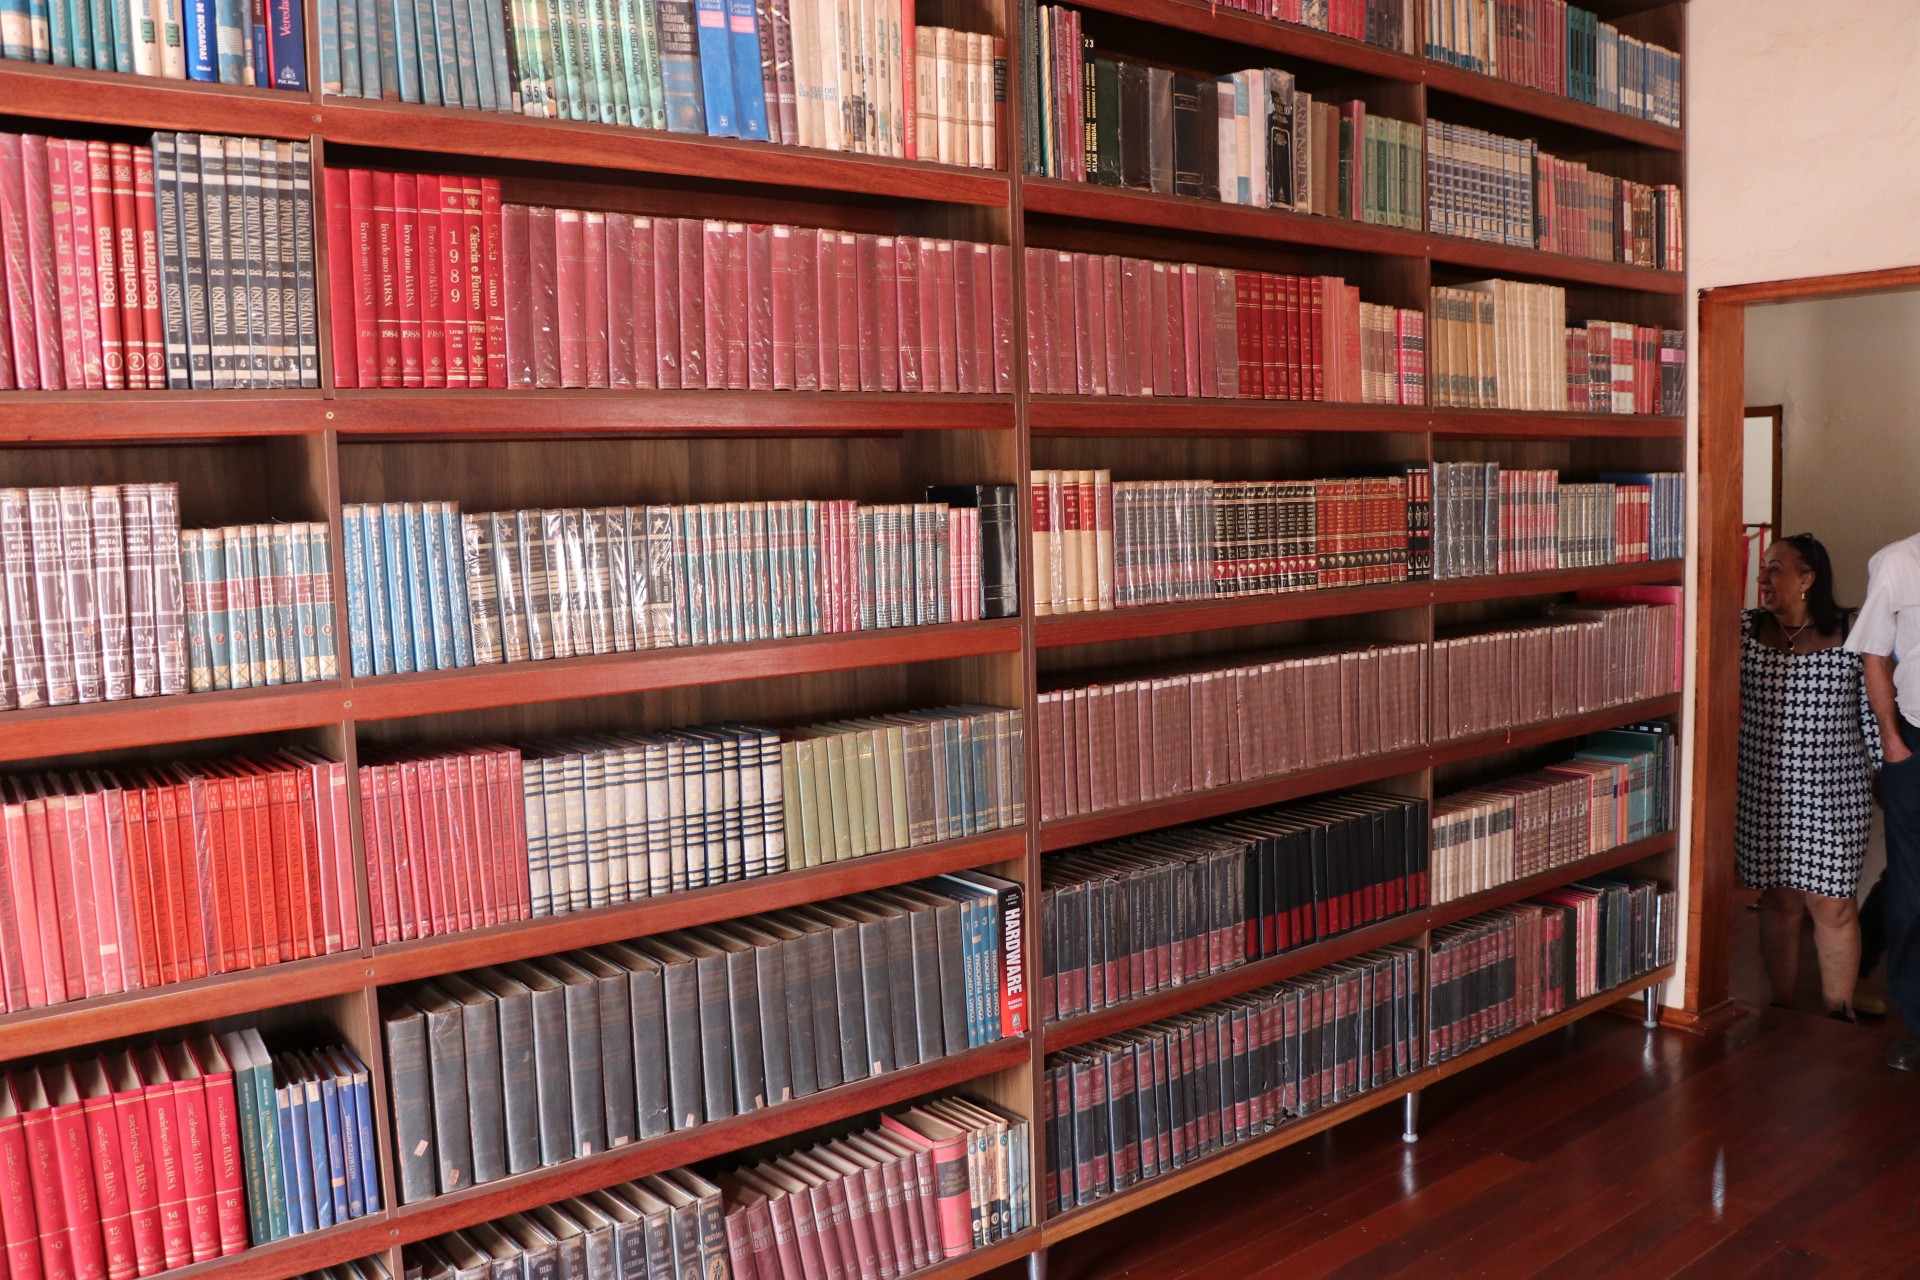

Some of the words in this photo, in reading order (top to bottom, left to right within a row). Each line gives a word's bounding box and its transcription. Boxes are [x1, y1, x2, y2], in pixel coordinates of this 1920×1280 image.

[661, 4, 677, 14] LISA
[662, 13, 685, 24] GRANDE
[197, 14, 208, 61] BIOGRAFIAS
[551, 18, 562, 66] MONTEIRO
[566, 19, 578, 66] MONTEIRO
[1084, 39, 1089, 48] 2
[1089, 39, 1094, 48] 3
[580, 23, 592, 70] MONTEIRO
[598, 24, 609, 71] MONTEIRO
[612, 24, 623, 72] MONTEIRO
[629, 27, 641, 75] MONTEIRO
[648, 30, 659, 77] MONTEIRO
[526, 85, 532, 98] 3
[534, 86, 540, 99] 5
[547, 87, 553, 99] 6
[906, 109, 916, 144] VIVER
[1296, 101, 1307, 202] DICTIONARY
[73, 160, 84, 174] 2
[161, 190, 178, 257] HUMANIDADE
[184, 192, 201, 258] HUMANIDADE
[207, 194, 224, 261] HUMANIDADE
[228, 194, 245, 261] HUMANIDADE
[246, 195, 262, 261] HUMANIDADE
[263, 197, 279, 262] HUMANIDADE
[280, 199, 295, 263] HUMANIDADE
[296, 199, 311, 262] HUMANIDADE
[360, 222, 369, 242] livro
[380, 223, 389, 243] livro
[403, 224, 412, 245] livro
[428, 225, 437, 245] livro
[362, 243, 370, 254] do
[381, 244, 390, 256] do
[404, 246, 413, 257] do
[428, 246, 437, 258] do
[469, 225, 480, 263] Ciência
[73, 185, 96, 341] NATURAMA
[98, 226, 116, 309] tecnirama
[120, 227, 139, 309] tecnirama
[141, 230, 159, 310] tecnirama
[165, 265, 180, 273] E
[362, 255, 370, 272] ano
[382, 256, 391, 273] ano
[405, 257, 414, 275] ano
[428, 258, 437, 274] ano
[449, 230, 460, 304] 1989
[232, 268, 246, 276] E
[249, 269, 263, 277] E
[266, 270, 279, 278] E
[299, 270, 312, 278] E
[363, 273, 372, 307] BARSA
[383, 274, 393, 307] BARSA
[406, 275, 415, 308] BARSA
[429, 275, 438, 308] BARSA
[472, 274, 482, 310] Futuro
[166, 282, 183, 333] UNIVERSO
[189, 284, 205, 334] UNIVERSO
[212, 286, 228, 335] UNIVERSO
[233, 285, 249, 335] UNIVERSO
[250, 286, 265, 335] UNIVERSO
[266, 287, 282, 336] UNIVERSO
[282, 288, 297, 336] UNIVERSO
[300, 287, 314, 335] UNIVERSO
[381, 330, 398, 338] 1984
[402, 330, 420, 338] 1988
[468, 325, 485, 334] 1990
[110, 354, 116, 368] 1
[132, 354, 139, 369] 2
[152, 354, 159, 368] 3
[175, 356, 180, 367] 1
[198, 356, 204, 367] 2
[219, 357, 226, 368] 3
[239, 357, 246, 368] 4
[256, 358, 263, 368] 5
[273, 358, 279, 368] 6
[305, 357, 312, 367] 8
[40, 541, 57, 549] DELTA
[71, 540, 88, 548] DELTA
[284, 778, 294, 786] RO
[966, 922, 970, 931] 1
[974, 920, 979, 928] 2
[982, 917, 987, 925] 3
[991, 917, 996, 925] 4
[1005, 907, 1022, 997] HARDWARE
[966, 955, 974, 996] FUNCIONA
[975, 952, 983, 994] FUNCIONA
[328, 1087, 333, 1096] 3
[345, 1115, 354, 1144] MODERNA
[194, 1152, 205, 1185] BARSA
[223, 1145, 234, 1179] BARSA
[348, 1144, 357, 1180] MATEMÁTICA
[135, 1164, 148, 1199] BARSA
[164, 1157, 177, 1191] BARSA
[196, 1205, 208, 1215] 15
[226, 1198, 237, 1207] 16
[139, 1218, 152, 1228] 13
[165, 1211, 178, 1220] 14
[707, 1211, 719, 1221] TITÃS
[108, 1226, 121, 1236] 12
[710, 1223, 717, 1231] DA
[627, 1238, 640, 1247] TITÃS
[704, 1231, 724, 1243] ORATÓRIA
[623, 1257, 645, 1269] LITERATURA
